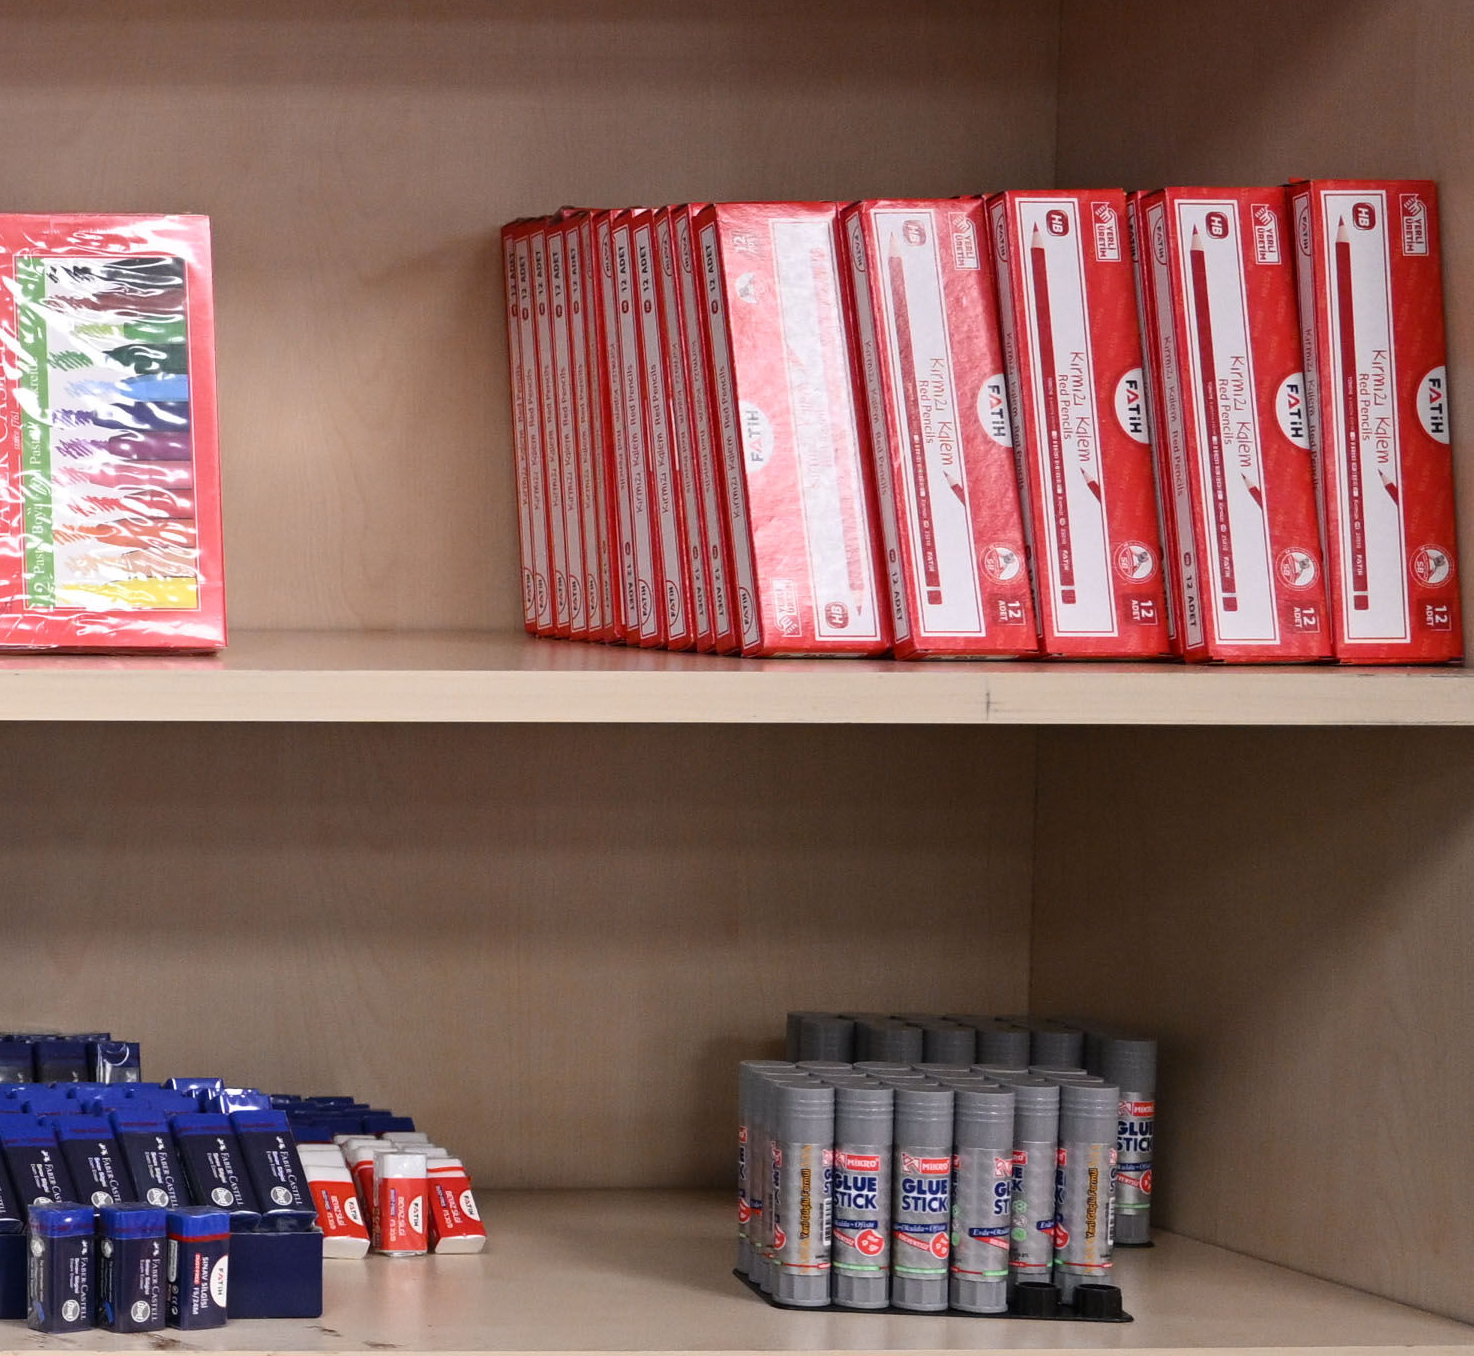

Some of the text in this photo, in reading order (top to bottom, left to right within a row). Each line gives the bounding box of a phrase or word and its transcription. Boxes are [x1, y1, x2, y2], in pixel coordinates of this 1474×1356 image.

[1051, 213, 1065, 233] HB
[1209, 215, 1223, 235] HB
[1357, 206, 1371, 227] HB
[907, 224, 922, 243] HB
[1105, 226, 1116, 251] YERLİ
[1264, 228, 1275, 253] YERLİ
[1413, 217, 1423, 243] YERLİ
[638, 246, 648, 274] ADET
[705, 244, 717, 293] 12 ADET
[641, 279, 650, 293] 12
[919, 380, 934, 444] Red Pencils
[1058, 373, 1073, 439] Red Pencils
[1218, 378, 1234, 445] Red Pencils
[1359, 372, 1373, 441] Red Pencils
[830, 606, 844, 624] HB
[999, 600, 1008, 621] ADET
[1008, 600, 1023, 618] 12
[1131, 599, 1141, 620] ADET
[1139, 599, 1154, 617] 12
[1293, 607, 1302, 628] ADET
[1301, 607, 1315, 626] 12
[1425, 604, 1434, 626] ADET
[1434, 605, 1449, 623] 12
[158, 1152, 178, 1208] FABER-CASTELL
[220, 1152, 244, 1205] FABER-CASTELL
[280, 1151, 302, 1205] FABER-CASTELL
[834, 1176, 877, 1192] GLUE
[902, 1179, 948, 1195] GLUE
[902, 1195, 948, 1213] STICK
[80, 1257, 88, 1320] FABER-CASTELL
[151, 1258, 160, 1321] FABER-CASTELL
[200, 1257, 209, 1308] SINAV SİLGİSİ
